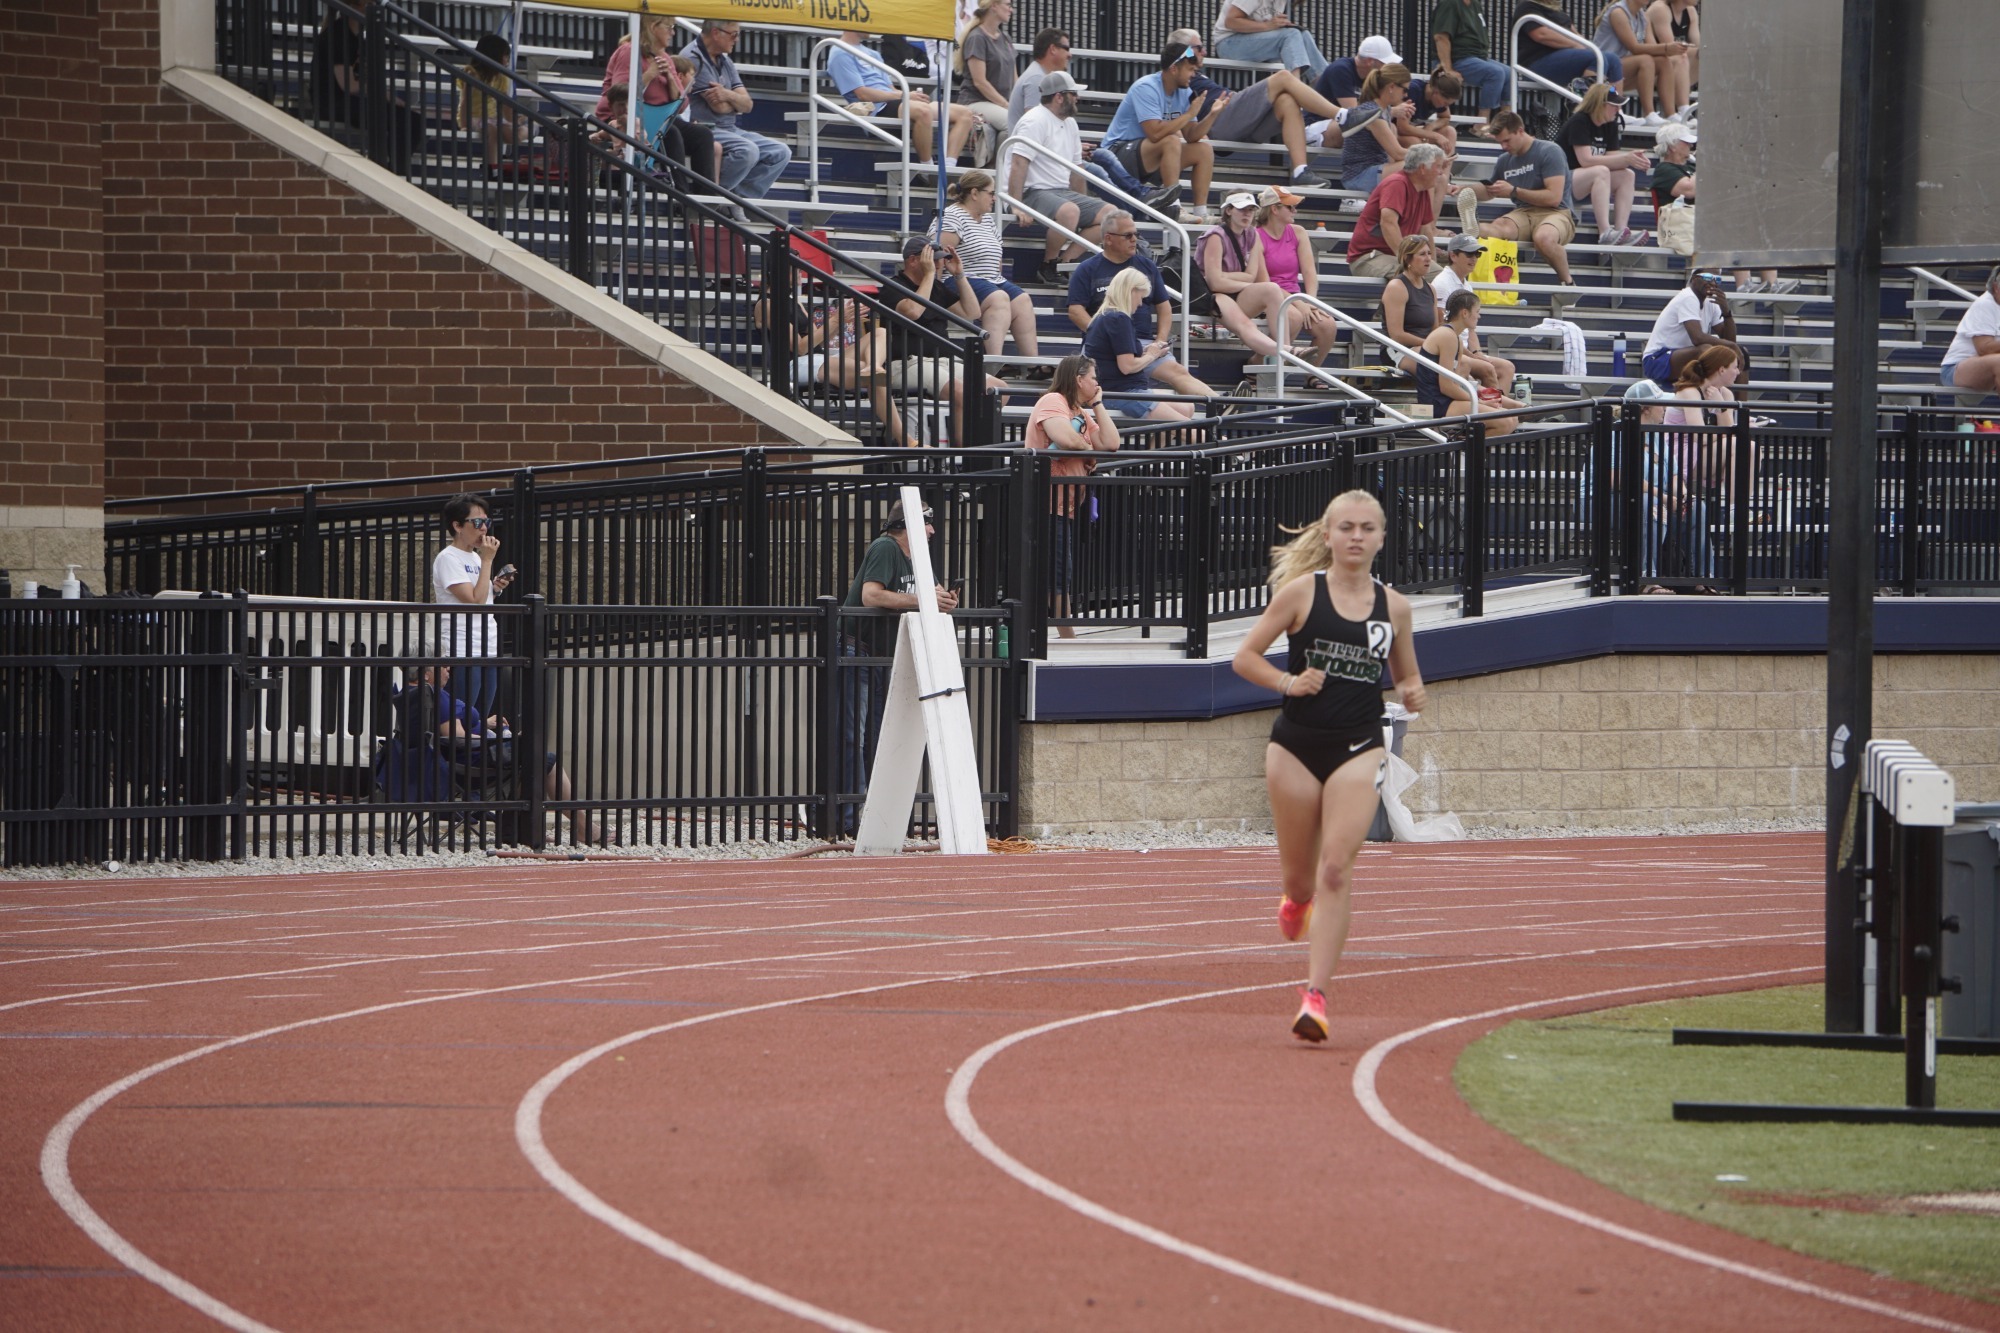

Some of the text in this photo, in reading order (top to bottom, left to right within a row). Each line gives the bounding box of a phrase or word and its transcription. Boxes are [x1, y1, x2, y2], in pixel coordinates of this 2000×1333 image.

[808, 0, 870, 23] TIGERS
[1314, 638, 1371, 661] WILLIA
[1370, 623, 1387, 660] 2
[1305, 649, 1383, 684] WOODS
